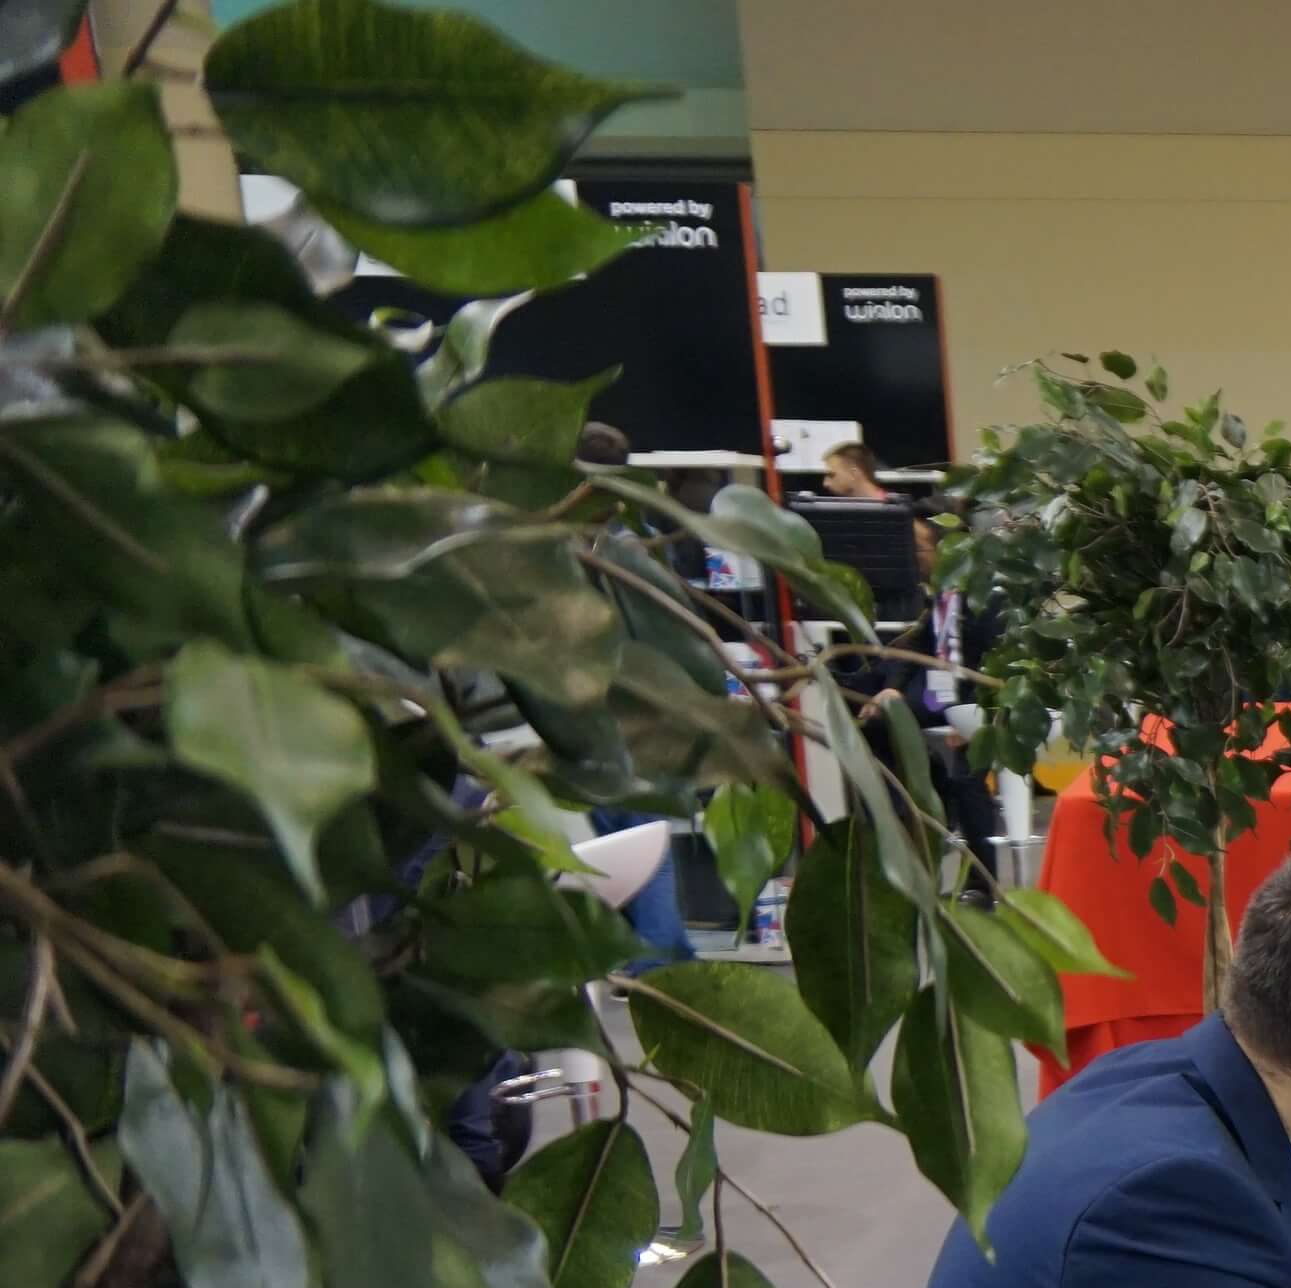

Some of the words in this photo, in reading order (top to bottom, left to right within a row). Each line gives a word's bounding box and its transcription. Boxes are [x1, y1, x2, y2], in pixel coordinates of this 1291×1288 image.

[610, 199, 686, 217] powered
[688, 199, 713, 220] by
[613, 220, 719, 249] alon
[843, 286, 896, 299] powered
[898, 285, 919, 301] by
[844, 301, 922, 321] wialon
